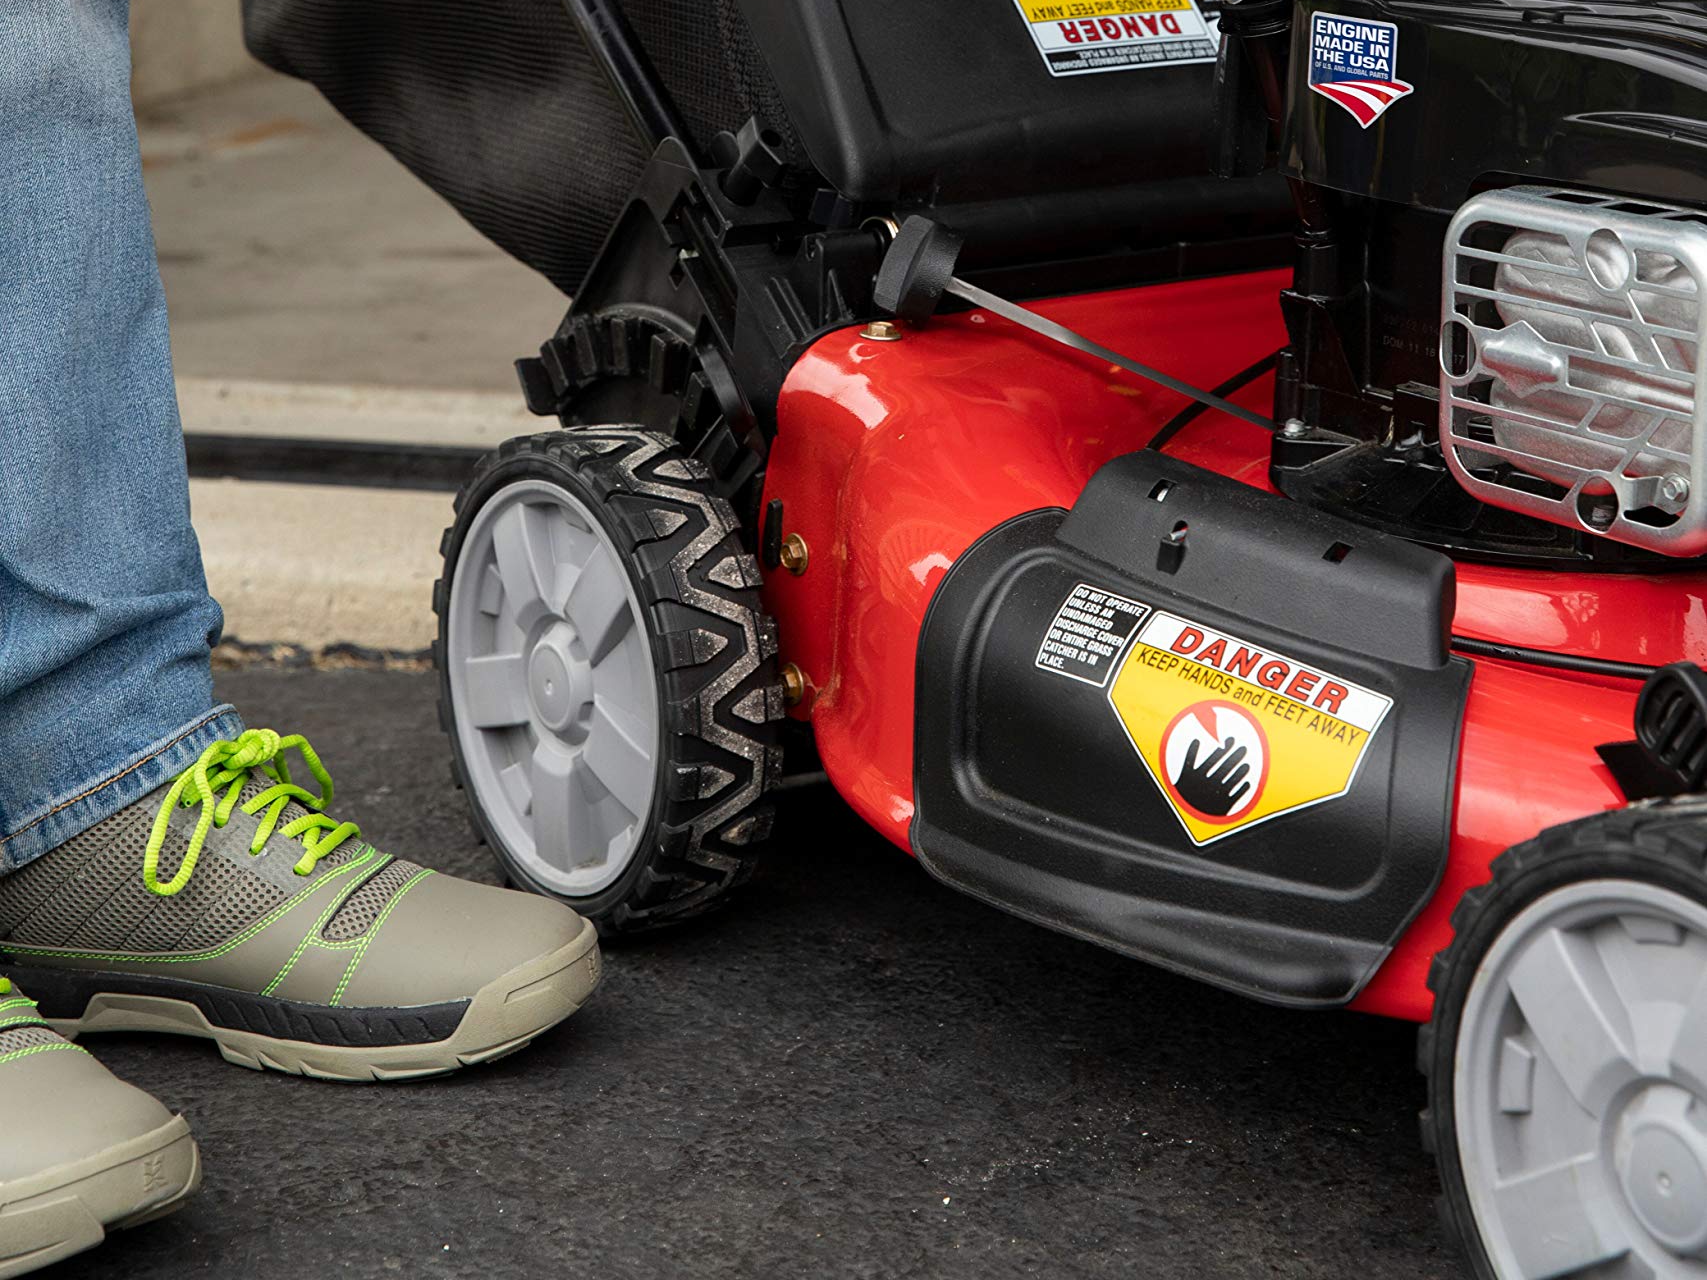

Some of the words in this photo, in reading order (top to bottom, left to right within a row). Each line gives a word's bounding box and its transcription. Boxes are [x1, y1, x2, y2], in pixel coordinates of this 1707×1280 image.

[1033, 7, 1065, 20] AWAY
[1069, 4, 1096, 17] FEET
[1099, 1, 1115, 11] and
[1116, 0, 1155, 12] HANDS
[1058, 13, 1182, 43] DANGER
[1316, 19, 1390, 44] ENGINE
[1315, 35, 1363, 54] MADE
[1370, 44, 1389, 58] IN
[1314, 48, 1344, 64] THE
[1349, 55, 1389, 72] USA
[1347, 67, 1368, 77] GLOBAL
[1369, 71, 1389, 80] PARTS
[1069, 598, 1101, 615] UNLESS
[1100, 608, 1115, 619] AN
[1076, 588, 1090, 599] DO
[1087, 592, 1108, 604] NOT
[1105, 598, 1144, 617] OPERATE
[1061, 607, 1113, 631] UNDAMAGED
[1049, 629, 1062, 640] OR
[1061, 632, 1089, 649] ENTIRE
[1086, 640, 1113, 657] GRASS
[1055, 617, 1099, 638] DISCHARGE
[1097, 631, 1125, 648] COVER
[1040, 653, 1064, 669] PLACE.
[1044, 640, 1079, 660] CATCHER
[1077, 651, 1088, 662] IS
[1087, 654, 1099, 666] IN
[1170, 626, 1349, 715] DANGER
[1137, 648, 1178, 672] KEEP
[1178, 662, 1234, 695] HANDS
[1233, 687, 1265, 707] and
[1264, 695, 1308, 724] FEET
[1307, 719, 1361, 746] AWAY
